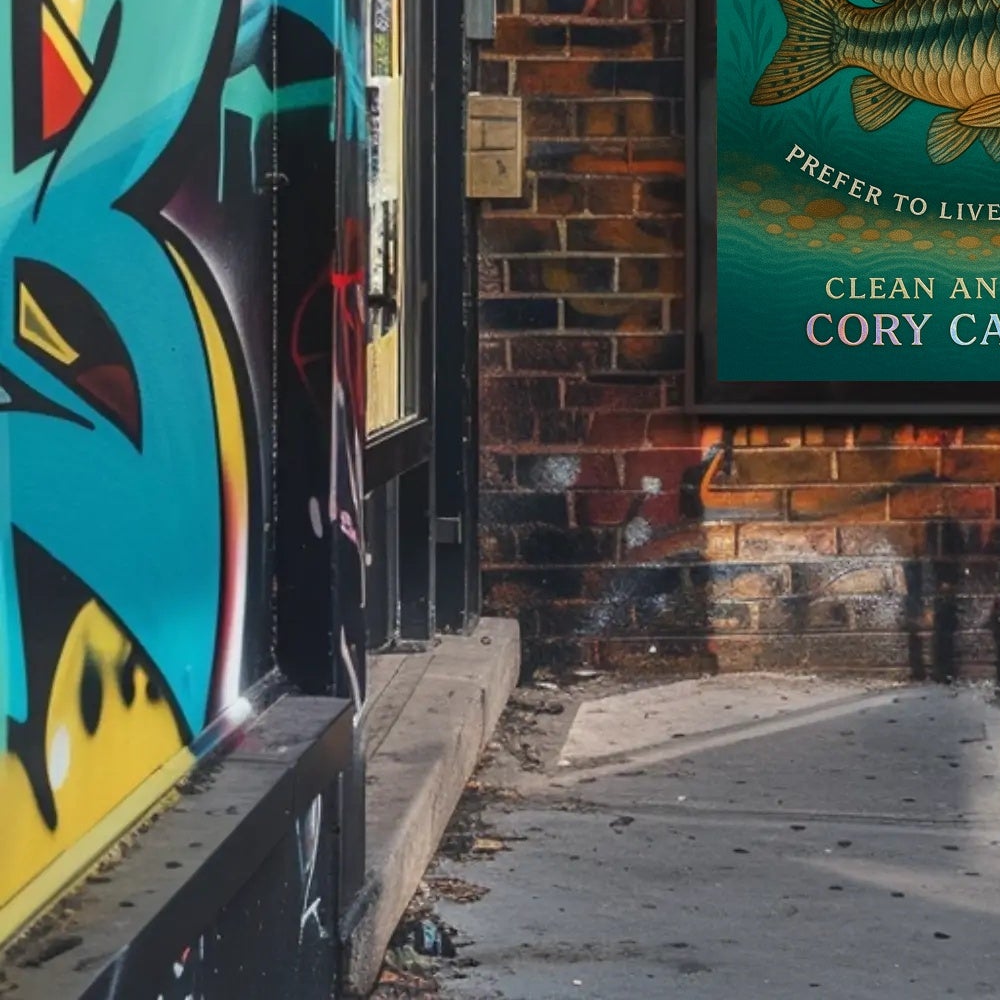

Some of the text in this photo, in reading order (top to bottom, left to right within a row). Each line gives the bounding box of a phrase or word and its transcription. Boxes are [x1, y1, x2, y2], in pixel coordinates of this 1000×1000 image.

[785, 143, 883, 206] PREFER
[893, 193, 928, 216] TO
[825, 277, 935, 300] CLEAN
[806, 313, 933, 346] CORY
